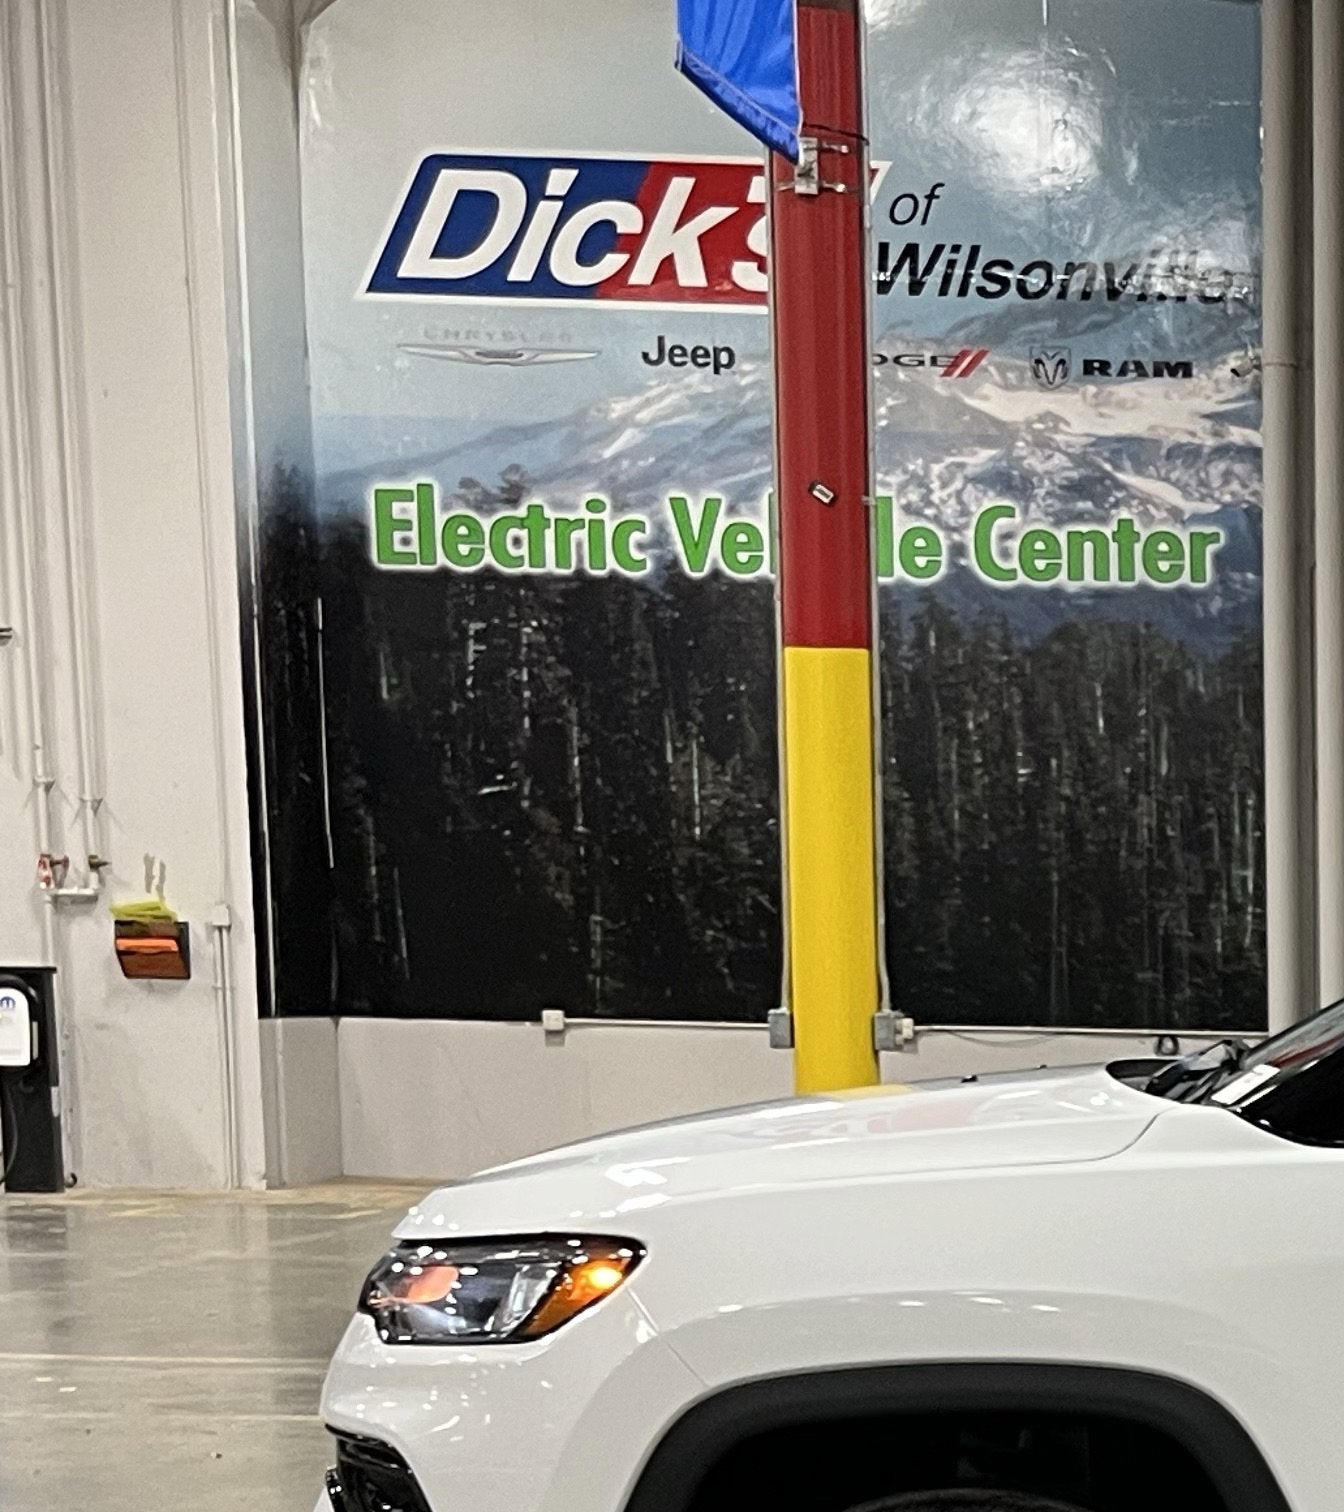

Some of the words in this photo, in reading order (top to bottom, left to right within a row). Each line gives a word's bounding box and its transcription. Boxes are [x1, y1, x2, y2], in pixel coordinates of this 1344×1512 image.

[888, 182, 946, 226] of
[641, 335, 736, 375] Jeep
[872, 353, 960, 367] DGE
[1083, 359, 1193, 378] RAM
[374, 483, 648, 573] Electric
[668, 496, 942, 579] Vele
[974, 505, 1221, 583] Center
